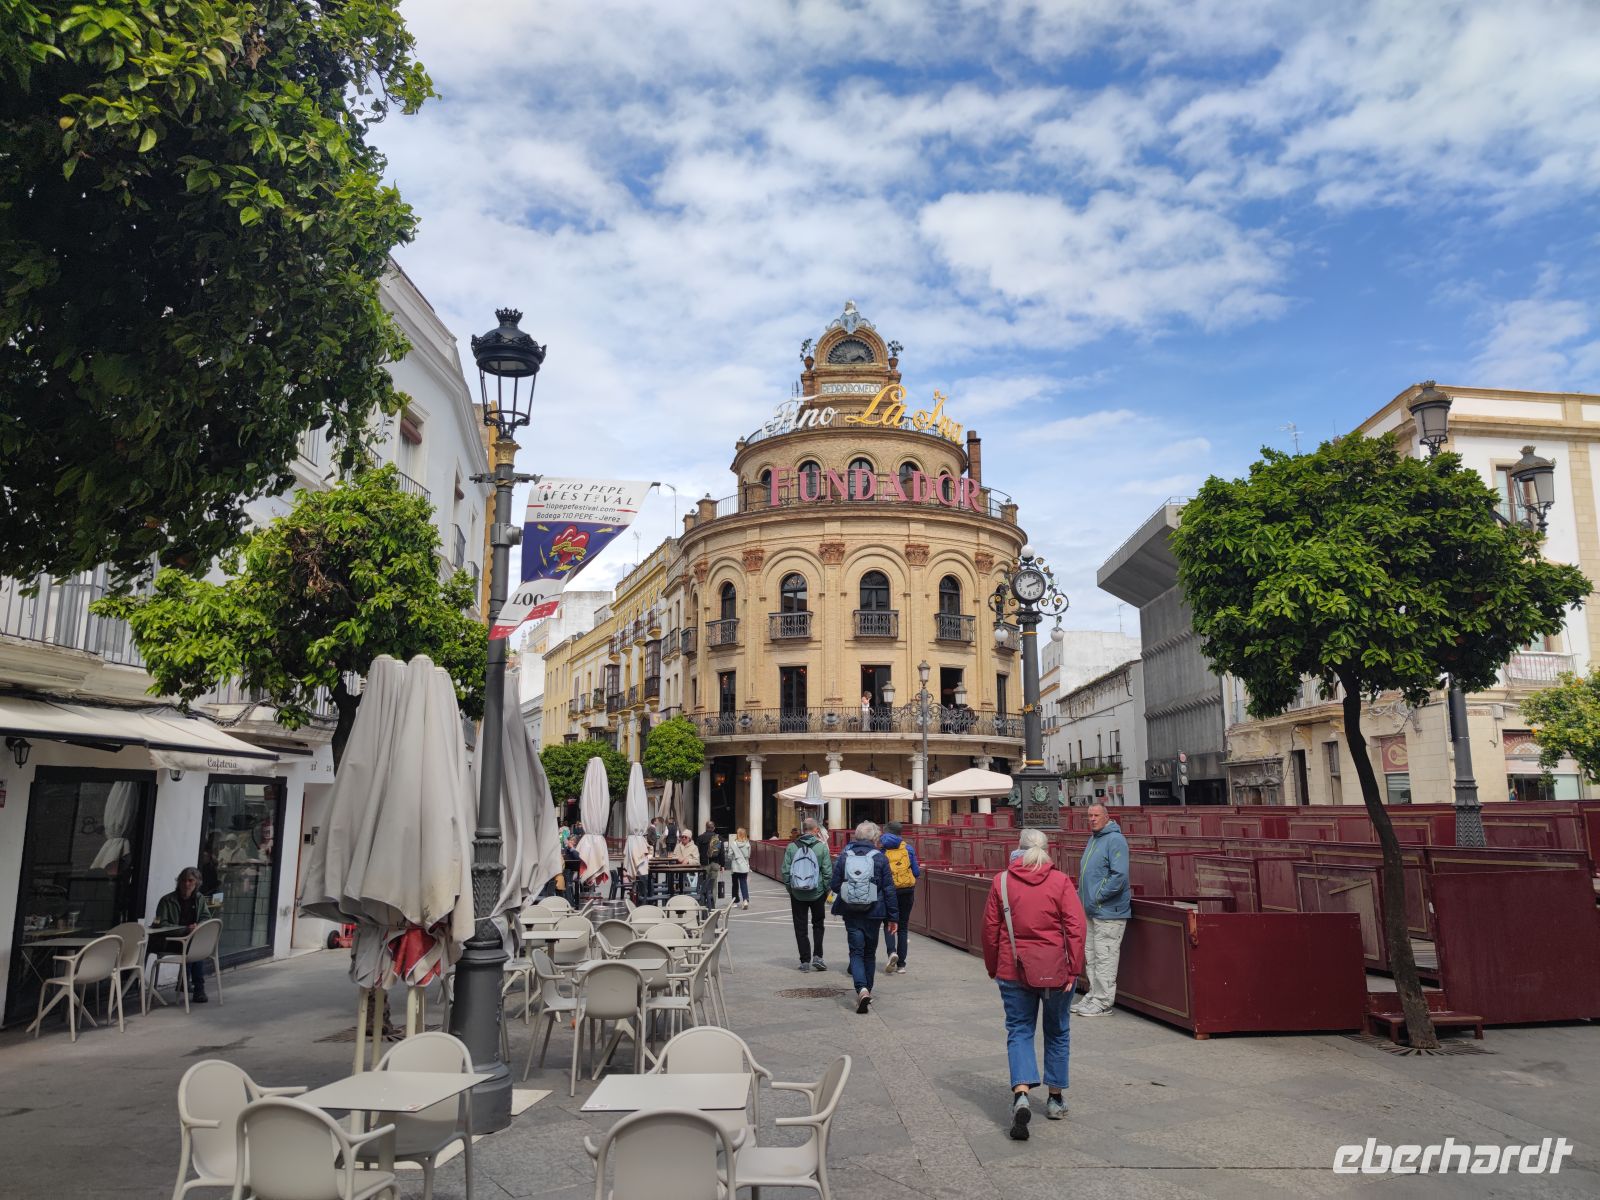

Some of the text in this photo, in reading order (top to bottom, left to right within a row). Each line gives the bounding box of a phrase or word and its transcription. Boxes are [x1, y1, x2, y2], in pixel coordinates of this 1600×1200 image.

[844, 383, 908, 427] La
[559, 483, 626, 495] TIO PEPE
[770, 466, 983, 513] FUNDADOR
[545, 503, 616, 513] tiopepefestival.com
[536, 512, 561, 520] Bodega
[599, 515, 621, 523] Jerez
[207, 757, 238, 771] Cafeteria
